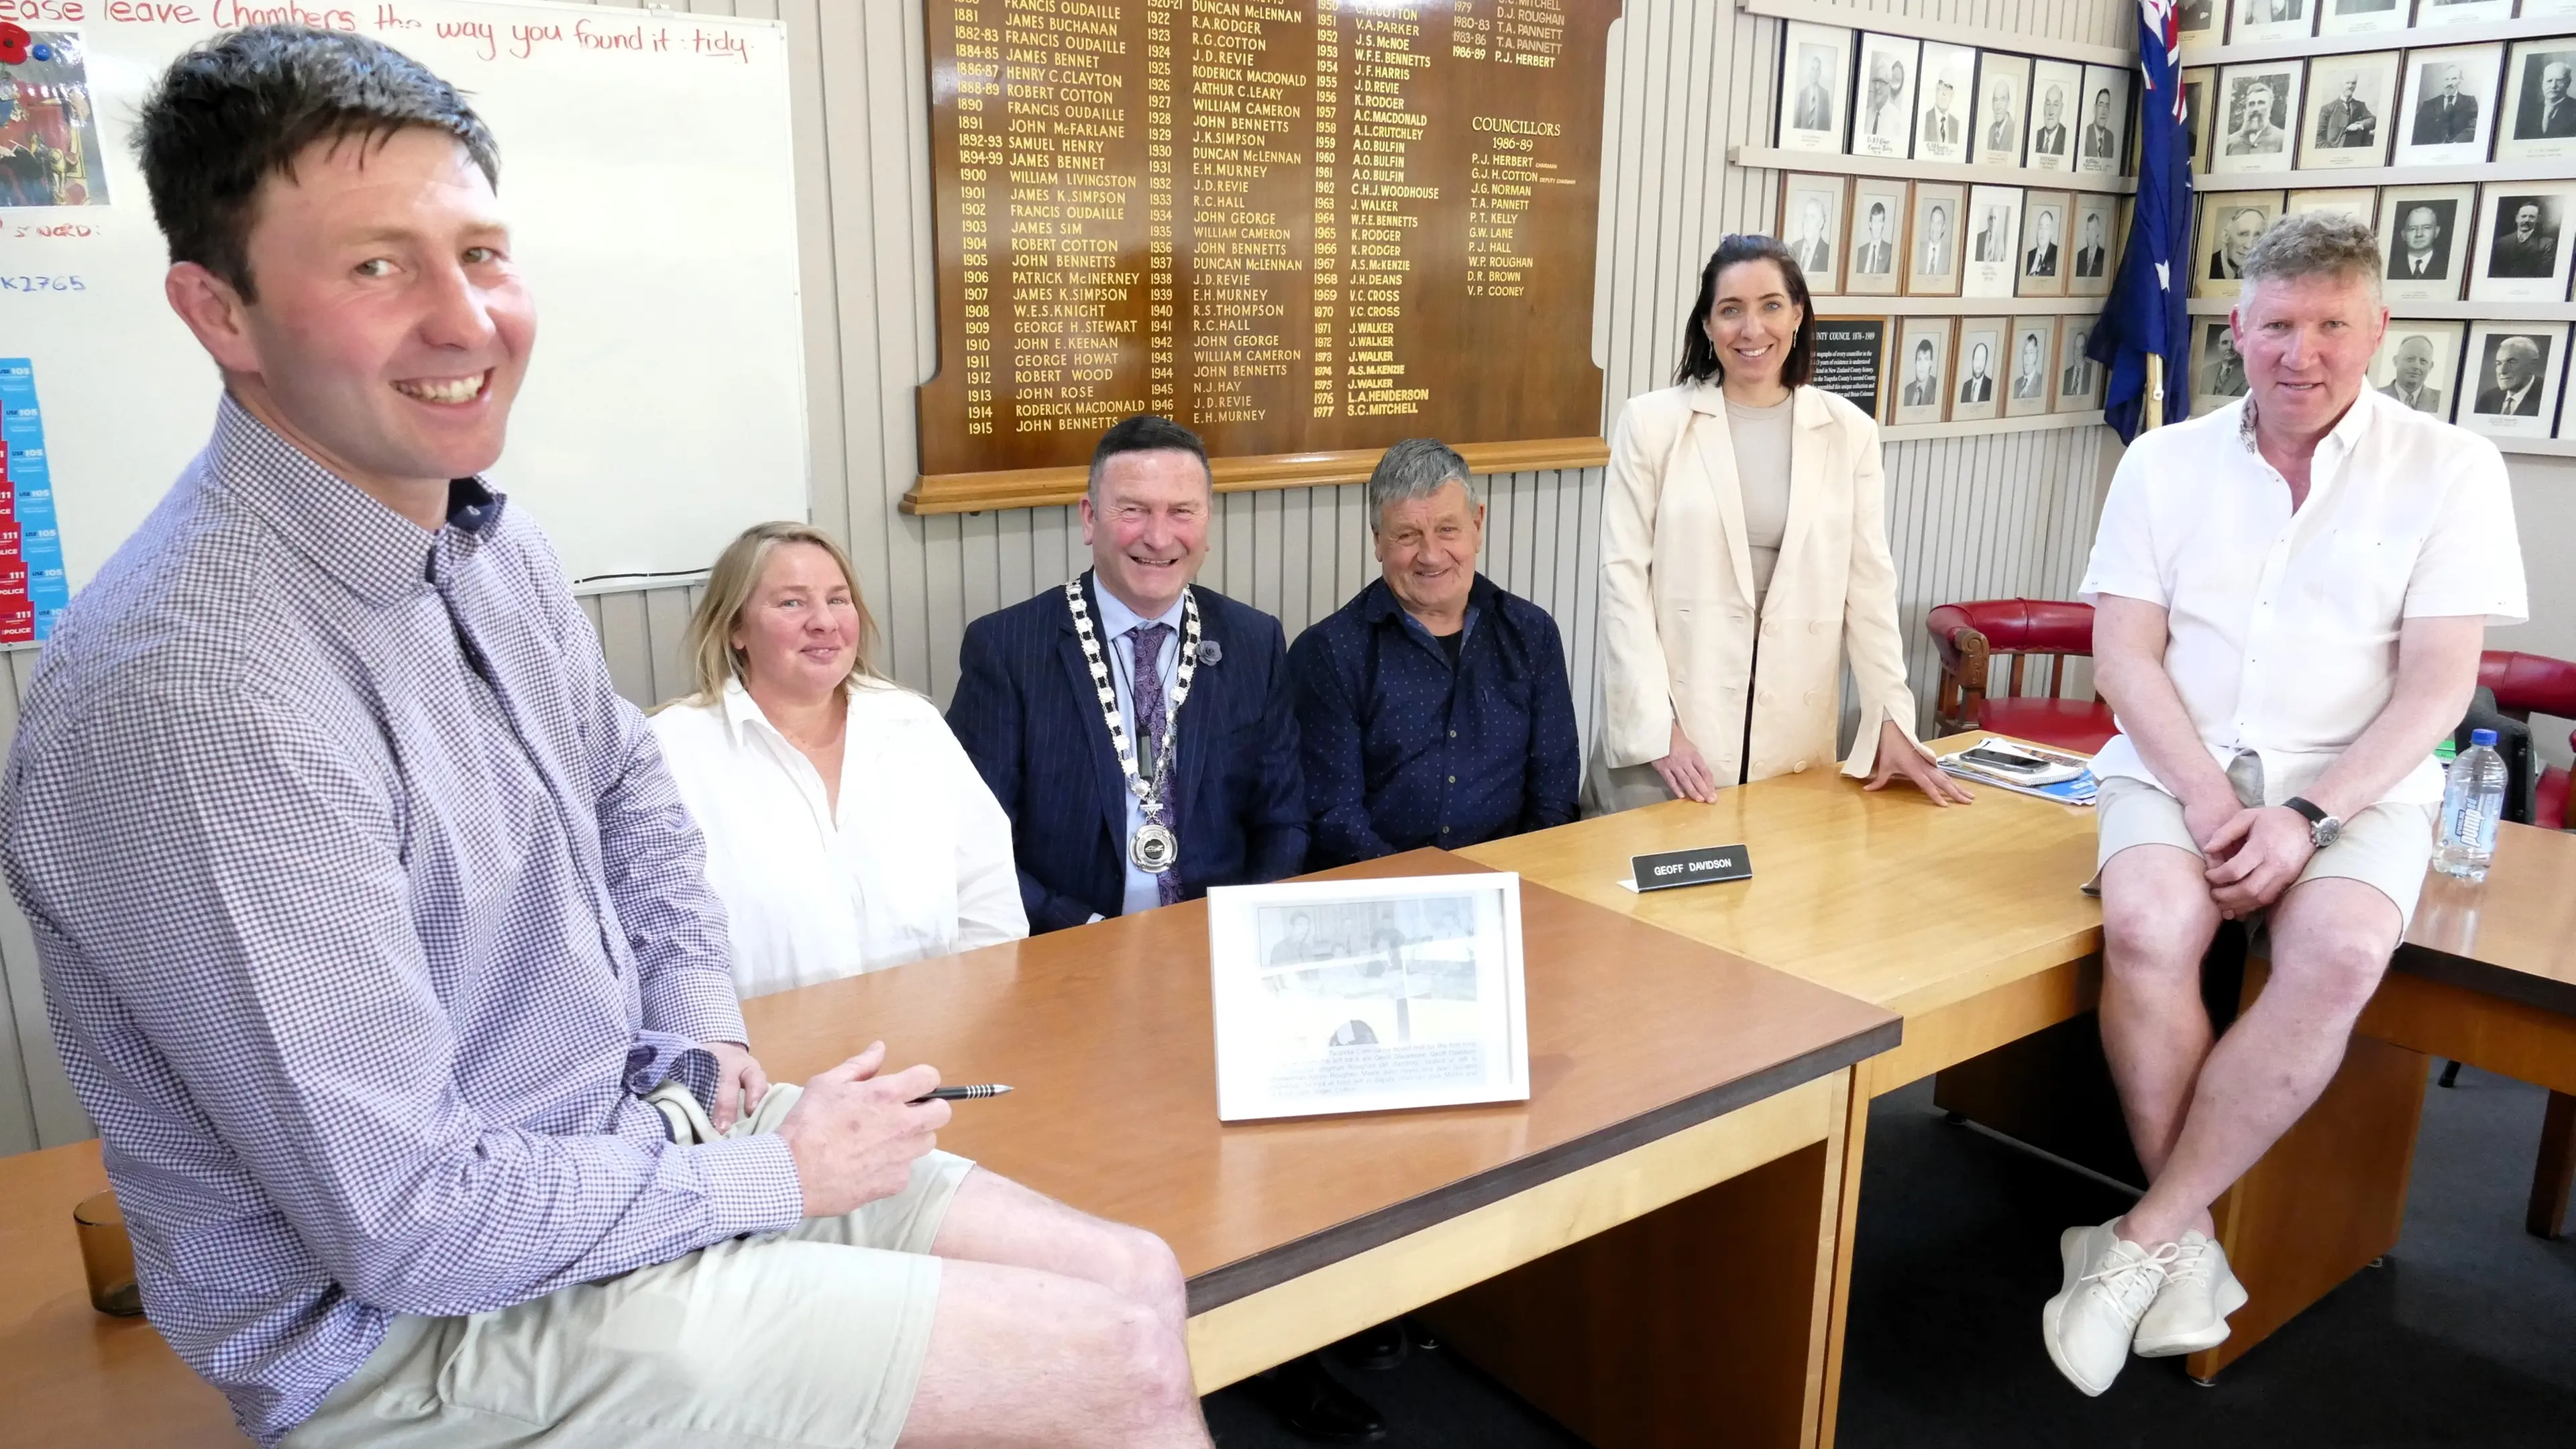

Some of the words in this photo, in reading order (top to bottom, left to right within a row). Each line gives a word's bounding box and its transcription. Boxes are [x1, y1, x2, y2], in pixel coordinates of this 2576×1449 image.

[954, 8, 978, 22] 1881
[1005, 13, 1044, 29] JAMES
[1049, 17, 1118, 36] BUCHANAN
[1318, 13, 1336, 26] 1951
[1518, 10, 1565, 25] ROUGHAN
[104, 0, 201, 23] leave
[436, 20, 496, 61] way
[509, 23, 563, 59] you
[575, 19, 644, 52] found
[653, 27, 670, 52] it
[1454, 16, 1491, 30] 1980-83
[1517, 24, 1563, 40] PANNETT
[955, 25, 999, 42] 1882-83
[1005, 30, 1059, 47] FRANCIS
[1065, 36, 1126, 54] OUDAILLE
[1317, 29, 1338, 43] 1952
[1317, 44, 1338, 58] 1953
[1385, 52, 1431, 67] BENNETTS
[1452, 46, 1486, 60] 1986-89
[1515, 53, 1556, 68] HERBERT
[1148, 61, 1171, 75] 1925
[1192, 65, 1243, 80] RODERICK
[1246, 70, 1307, 87] MACDONALD
[1317, 75, 1338, 88] 1955
[958, 81, 1000, 95] 1888-89
[1007, 84, 1055, 99] ROBERT
[1060, 88, 1113, 104] COTTON
[1148, 95, 1171, 108] 1927
[1192, 98, 1240, 113] WILLIAM
[1246, 103, 1301, 118] CAMERON
[959, 115, 983, 129] 1891
[1008, 119, 1046, 133] JOHN
[1054, 122, 1125, 138] McFARLANE
[1316, 121, 1337, 133] 1958
[1472, 117, 1561, 136] COUNCILLORS
[1493, 137, 1534, 152] 1986-89
[959, 150, 1004, 165] 1894-99
[1009, 153, 1050, 167] JAMES
[1057, 156, 1105, 170] BENNET
[1148, 144, 1172, 157] 1930
[1193, 147, 1238, 160] DUNCAN
[1243, 150, 1301, 164] McLENNAN
[1493, 154, 1534, 167] HERBERT
[961, 168, 987, 181] 1900
[1009, 171, 1058, 184] WILLIAM
[1067, 174, 1136, 188] LIVINGSTON
[1491, 184, 1532, 196] NORMAN
[1150, 210, 1173, 221] 1934
[1193, 211, 1225, 223] JOHN
[1230, 212, 1276, 225] GEORGE
[1315, 213, 1335, 223] 1964
[1491, 213, 1518, 224] KELLY
[1490, 228, 1513, 238] LANE
[963, 237, 987, 250] 1904
[1011, 238, 1057, 251] ROBERT
[1061, 239, 1118, 252] COTTON
[1489, 242, 1511, 252] HALL
[1150, 257, 1173, 268] 1937
[1193, 258, 1242, 270] DUNCAN
[1246, 258, 1302, 270] McLENNAN
[1489, 257, 1534, 267] ROUGHAN
[964, 271, 989, 282] 1906
[1012, 272, 1063, 284] PATRICK
[1069, 272, 1140, 284] McINERNEY
[1489, 272, 1521, 282] BROWN
[1314, 289, 1338, 301] 1969
[1367, 290, 1400, 302] CROSS
[1488, 286, 1525, 296] COONEY
[1314, 323, 1331, 333] 1971
[967, 356, 989, 368] 1911
[1014, 354, 1067, 366] GEORGE
[1074, 353, 1119, 365] HOWAT
[1151, 352, 1173, 363] 1943
[1193, 351, 1242, 362] WILLIAM
[1246, 350, 1301, 360] CAMERON
[967, 372, 991, 384] 1912
[1015, 370, 1062, 383] ROBERT
[1071, 369, 1113, 381] WOOD
[968, 390, 992, 402] 1913
[1016, 388, 1053, 399] JOHN
[1061, 386, 1093, 398] ROSE
[1313, 392, 1334, 404] 1976
[968, 406, 994, 419] 1914
[1016, 403, 1072, 416] RODERICK
[1075, 400, 1145, 414] MACDONALD
[1313, 406, 1335, 417] 1977
[1654, 864, 1684, 876] GEOFF
[1688, 859, 1732, 872] DAVIDSON
